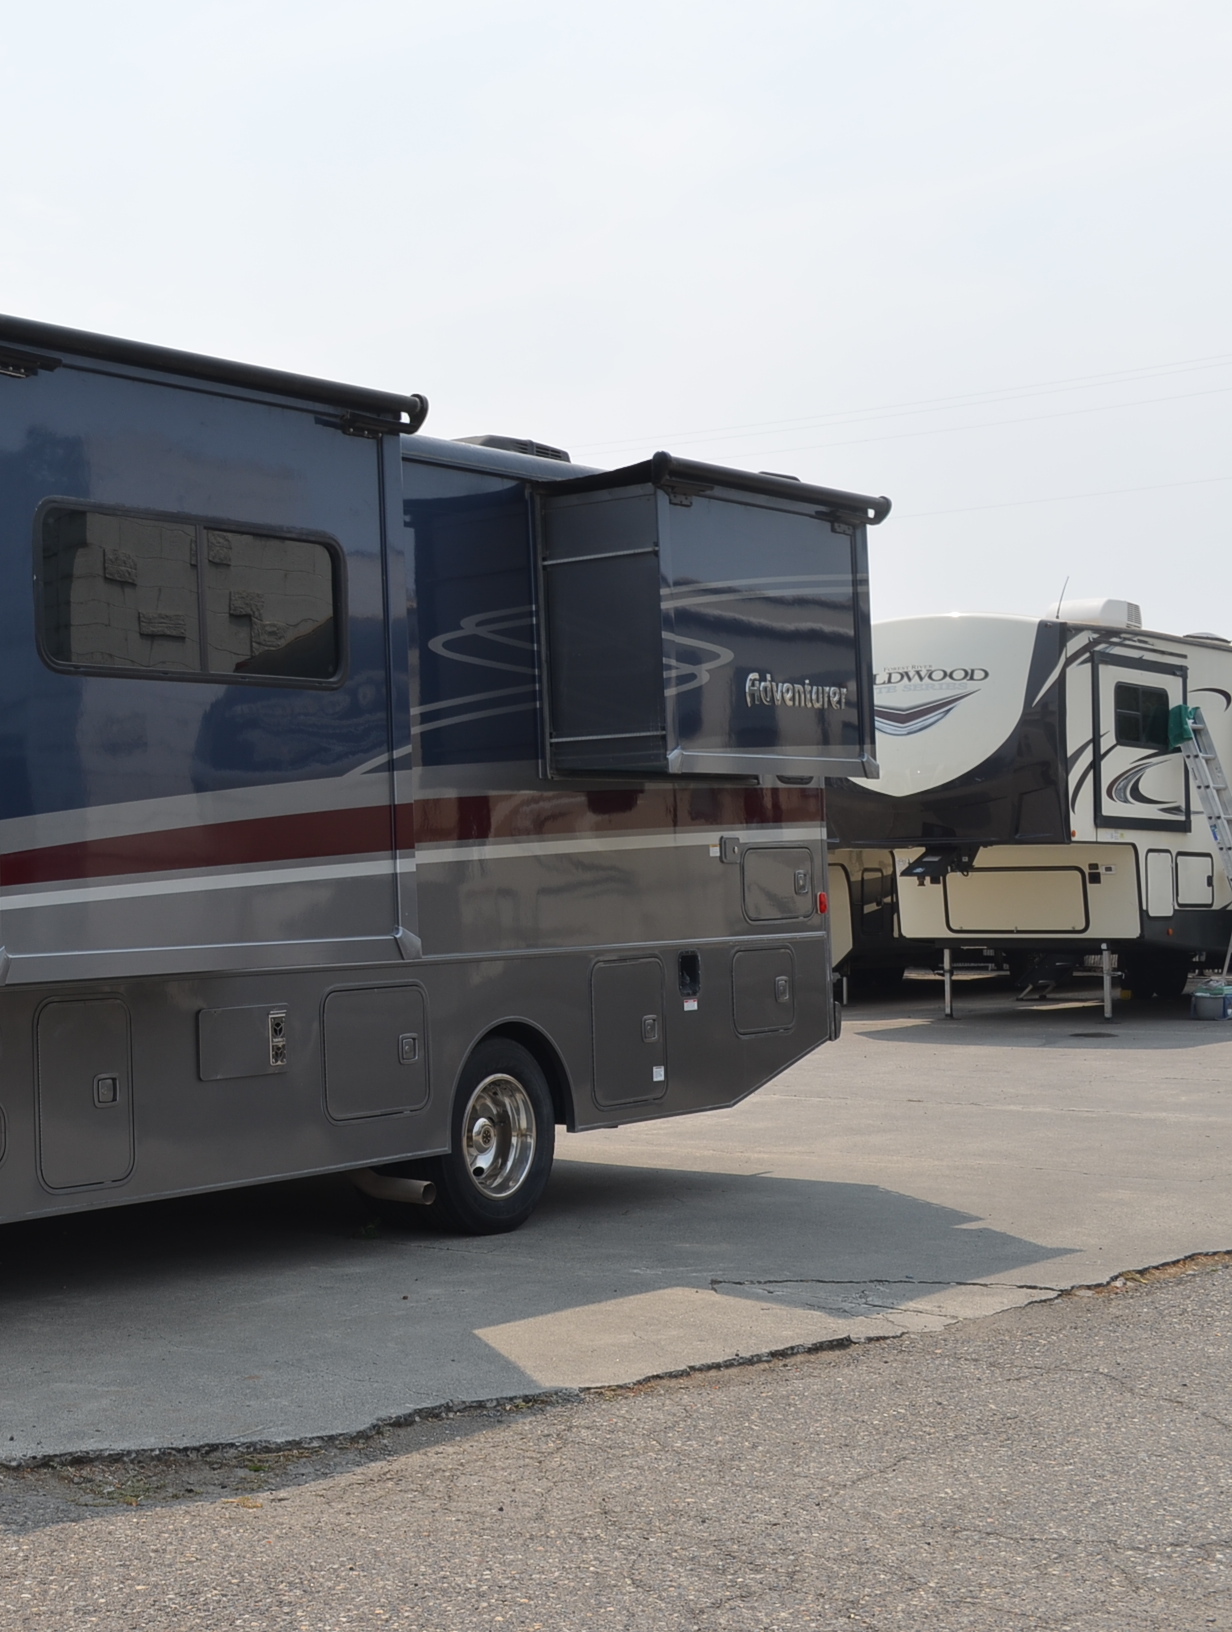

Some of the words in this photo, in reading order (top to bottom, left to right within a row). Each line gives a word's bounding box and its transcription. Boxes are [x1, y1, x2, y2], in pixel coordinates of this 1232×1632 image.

[872, 668, 990, 686] LDWOOD
[746, 672, 847, 709] Adventurer
[874, 685, 898, 694] TE
[902, 682, 968, 692] SERIES
